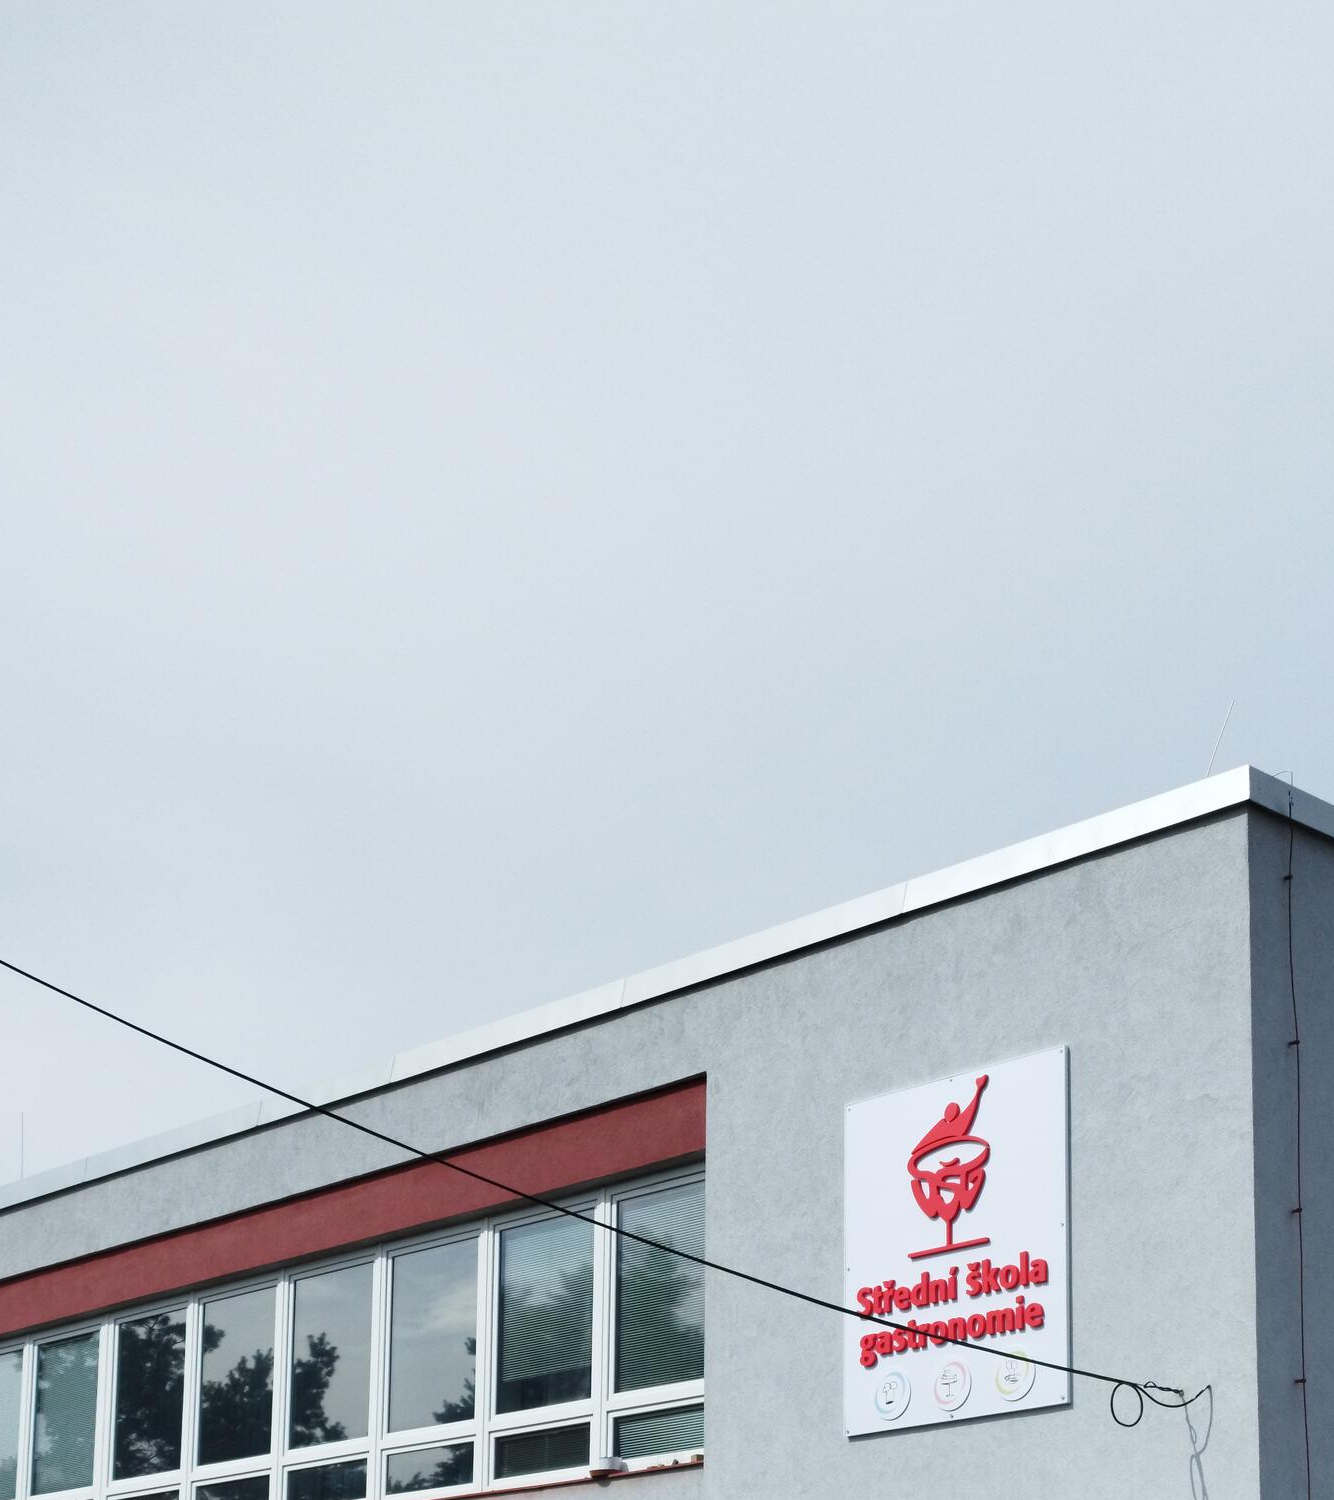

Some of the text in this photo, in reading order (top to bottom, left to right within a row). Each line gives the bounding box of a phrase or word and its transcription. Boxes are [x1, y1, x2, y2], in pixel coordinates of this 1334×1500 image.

[856, 1250, 1048, 1316] Střední škola
[859, 1295, 1045, 1367] gastronomie
